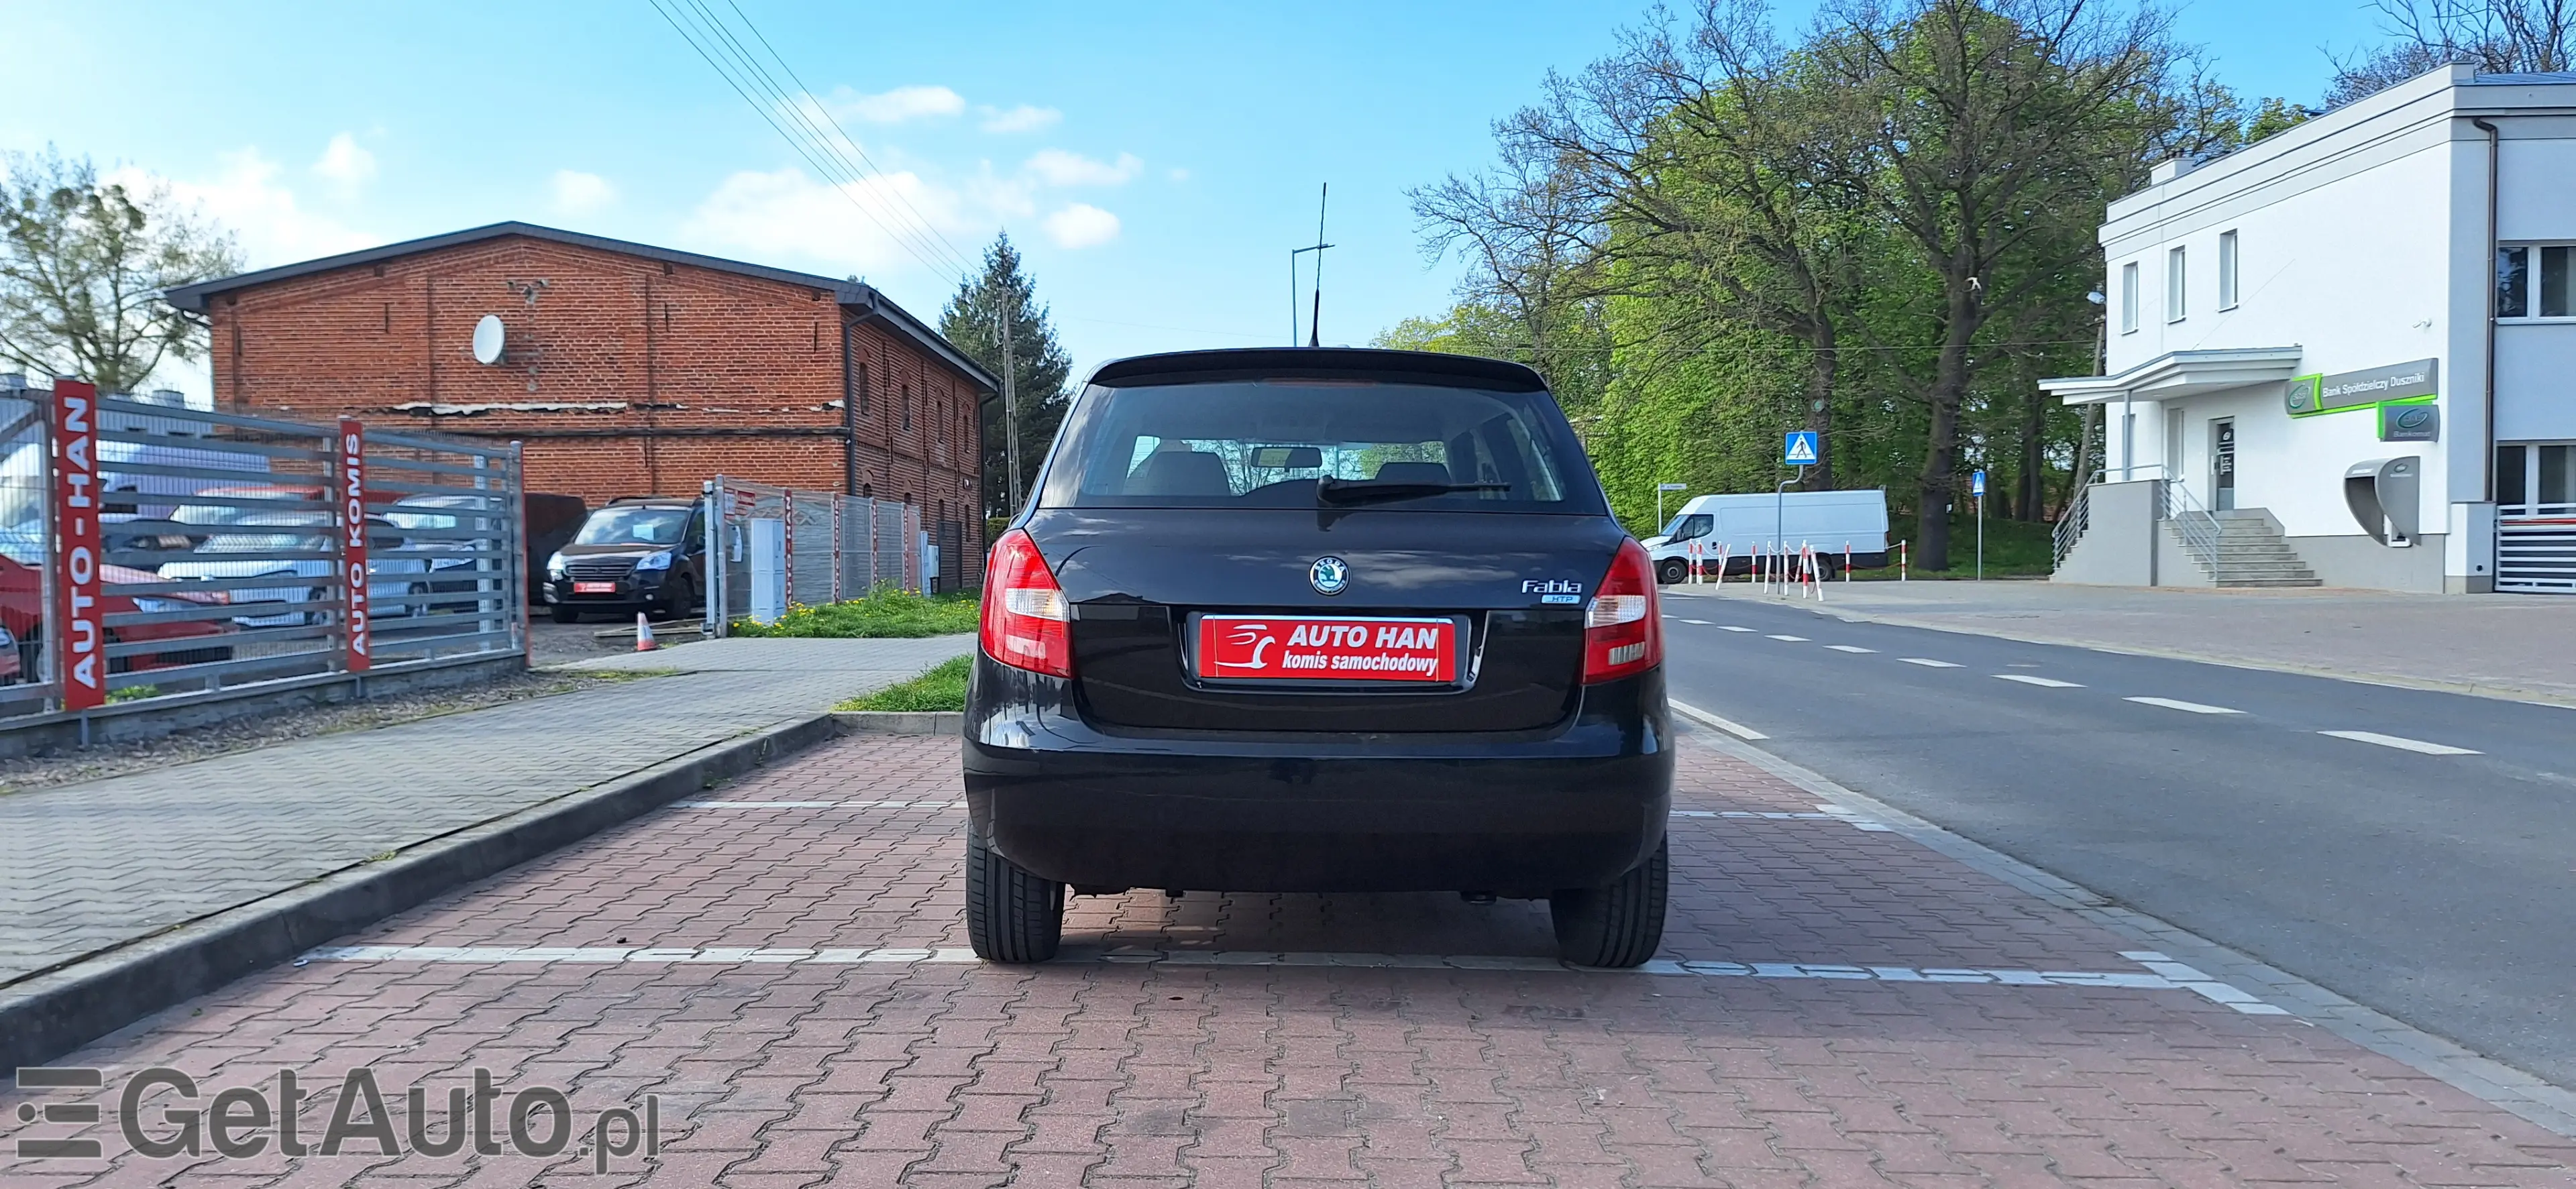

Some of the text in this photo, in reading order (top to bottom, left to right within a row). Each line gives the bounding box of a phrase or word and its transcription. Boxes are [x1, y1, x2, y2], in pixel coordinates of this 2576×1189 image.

[2322, 386, 2341, 397] Bank
[2342, 380, 2389, 396] Spółdzielczy
[2390, 372, 2425, 387] Duszniki
[64, 396, 96, 689] AUTO-HAN
[345, 433, 366, 655] AUTO KOMIS
[1521, 579, 1583, 593] Fabia
[1287, 624, 1438, 650] AUTO HAN
[1282, 650, 1438, 676] komis samochodowy
